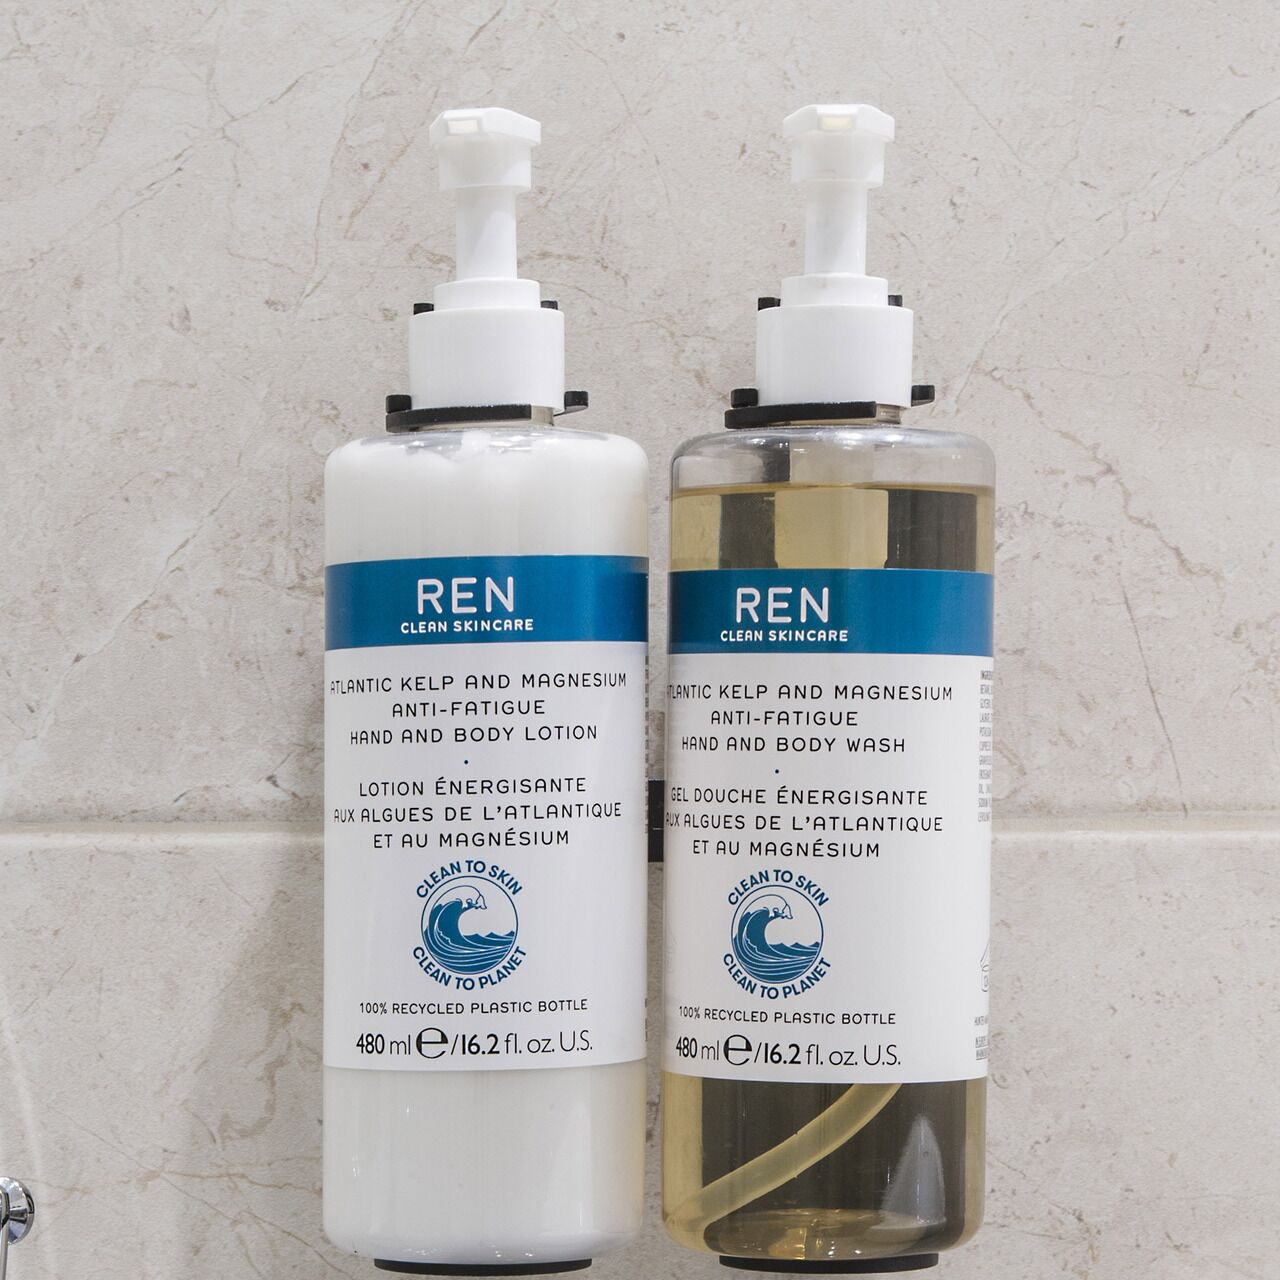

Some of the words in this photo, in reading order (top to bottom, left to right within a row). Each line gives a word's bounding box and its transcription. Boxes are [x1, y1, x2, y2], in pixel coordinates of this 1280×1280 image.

[417, 575, 514, 615] REN
[735, 586, 829, 624] REN
[400, 620, 448, 634] CLEAN
[453, 618, 534, 633] SKINCARE
[720, 629, 763, 642] CLEAN
[768, 629, 849, 643] SKINCARE
[330, 677, 392, 695] ATLANTIC
[400, 675, 455, 692] KELP
[465, 674, 511, 690] AND
[521, 672, 627, 689] MAGNESIUM
[719, 684, 768, 700] KELP
[778, 684, 823, 700] AND
[834, 684, 952, 701] MAGNESIUM
[392, 699, 546, 719] ANTI-FATIGUE
[710, 710, 859, 727] ANTI-FATIGUE
[350, 729, 393, 745] HAND
[401, 728, 443, 744] AND
[454, 726, 515, 743] BODY
[525, 724, 597, 742] LOTION
[681, 735, 719, 752] HAND
[726, 736, 766, 752] AND
[776, 736, 837, 753] BODY
[846, 737, 905, 753] WASH
[359, 780, 424, 797] LOTION
[435, 775, 587, 796] ÉNERGISANTE
[670, 786, 689, 802] GEL
[694, 787, 767, 805] DOUCHE
[776, 784, 928, 806] ÉNERGISANTE
[333, 808, 355, 824] AUX
[360, 806, 434, 823] ALGUES
[444, 805, 473, 822] DE
[683, 812, 746, 830] ALGUES
[755, 815, 782, 831] DE
[373, 833, 393, 849] ET
[401, 833, 428, 849] AU
[439, 826, 569, 848] MAGNÉSIUM
[692, 839, 710, 855] ET
[716, 840, 740, 856] AU
[749, 837, 880, 858] MAGNÉSIUM
[416, 861, 462, 898] CLEAN
[465, 860, 486, 874] TO
[488, 866, 523, 896] SKIN
[728, 870, 770, 906] CLEAN
[773, 869, 793, 883] TO
[796, 875, 829, 906] SKIN
[413, 947, 450, 986] CLEAN
[455, 977, 475, 991] TO
[479, 946, 527, 989] PLANET
[723, 954, 757, 995] CLEAN
[760, 986, 780, 1000] TO
[783, 957, 831, 998] PLANET
[359, 1001, 388, 1016] 100%
[392, 1002, 465, 1015] RECYCLED
[470, 1000, 533, 1014] PLASTIC
[538, 998, 588, 1013] BOTTLE
[679, 1005, 701, 1020] 100%
[703, 1007, 769, 1023] RECYCLED
[773, 1011, 836, 1025] PLASTIC
[841, 1012, 897, 1025] BOTTLE
[355, 1032, 386, 1055] 480
[389, 1033, 411, 1056] ml
[503, 1032, 523, 1055] fl.
[526, 1038, 556, 1054] oz.
[559, 1029, 593, 1053] U.S.
[675, 1035, 698, 1059] 480
[700, 1039, 720, 1061] ml
[805, 1043, 824, 1066] fl.
[828, 1050, 858, 1066] oz.
[863, 1043, 901, 1066] U.S.
